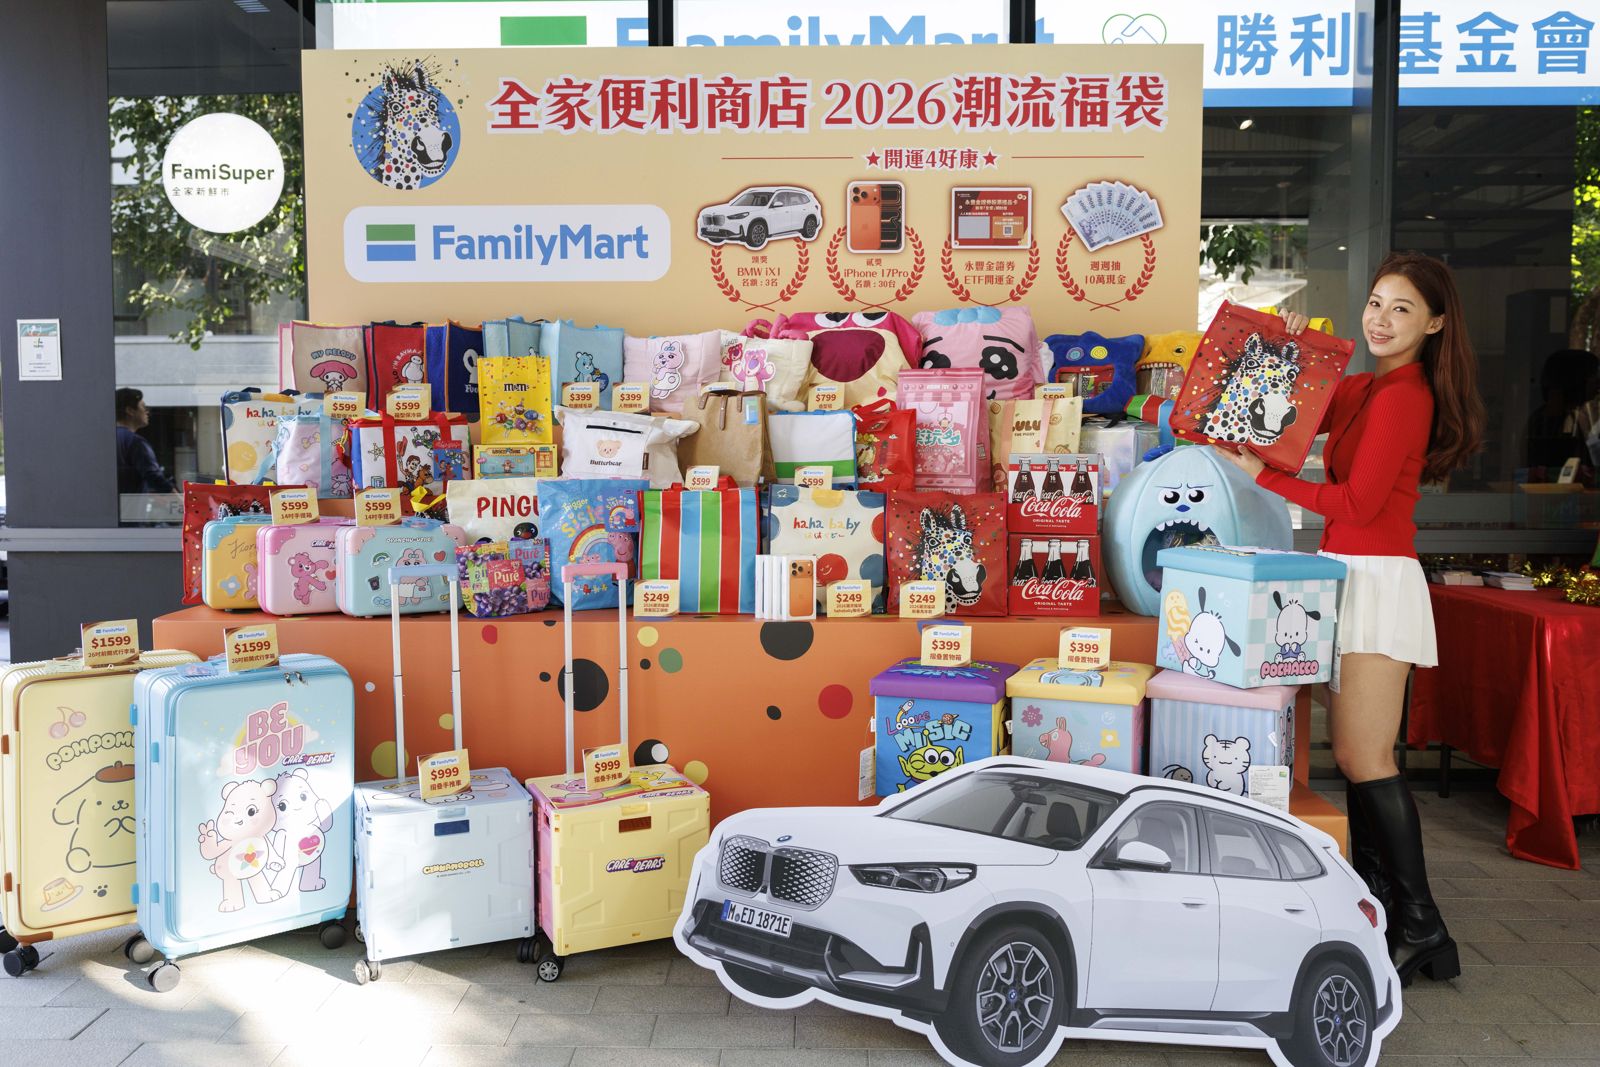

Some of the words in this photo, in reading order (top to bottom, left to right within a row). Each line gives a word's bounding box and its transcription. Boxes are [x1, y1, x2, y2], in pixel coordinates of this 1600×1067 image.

[489, 76, 810, 131] 全家便利商店
[823, 75, 1166, 130] 2026潮流福袋
[883, 148, 980, 171] 開運4好康
[171, 163, 275, 184] FamiSuper
[172, 186, 230, 197] 全家新鮮市
[432, 223, 649, 266] FamilyMart
[964, 261, 1016, 272] 永豐金證券
[1090, 260, 1121, 272] 週週抽
[737, 267, 762, 278] BMW
[844, 268, 878, 279] iPhone
[879, 268, 909, 279] 17Pro
[963, 273, 1015, 285] ETF開運金
[1084, 273, 1127, 285] 10萬現金
[569, 393, 592, 402] $399
[620, 393, 642, 402] $399
[815, 394, 837, 403] $799
[332, 402, 357, 412] $599
[395, 402, 420, 411] $599
[246, 407, 277, 419] haha
[590, 459, 622, 467] Butterbear
[691, 477, 711, 486] $599
[802, 478, 825, 487] $599
[281, 501, 309, 511] $599
[364, 502, 392, 512] $599
[793, 516, 824, 530] haha
[829, 516, 861, 536] baby
[643, 592, 670, 603] $249
[836, 592, 862, 603] $249
[908, 594, 936, 604] $249
[102, 626, 126, 634] FamilyMart
[244, 631, 266, 640] FamilyMart
[91, 635, 131, 650] $1599
[234, 640, 272, 655] $1599
[931, 639, 961, 652] $399
[1069, 641, 1100, 654] $399
[1260, 659, 1320, 679] POCHACCO
[282, 752, 304, 766] CARE
[306, 752, 335, 766] BEARS
[599, 750, 619, 759] FamilyMart
[436, 758, 458, 767] FamilyMart
[594, 760, 621, 774] $999
[430, 766, 460, 781] $999
[606, 857, 630, 873] CARE
[633, 856, 666, 873] BEARS
[727, 903, 736, 921] M
[740, 905, 755, 924] ED
[756, 910, 790, 935] 1871E
